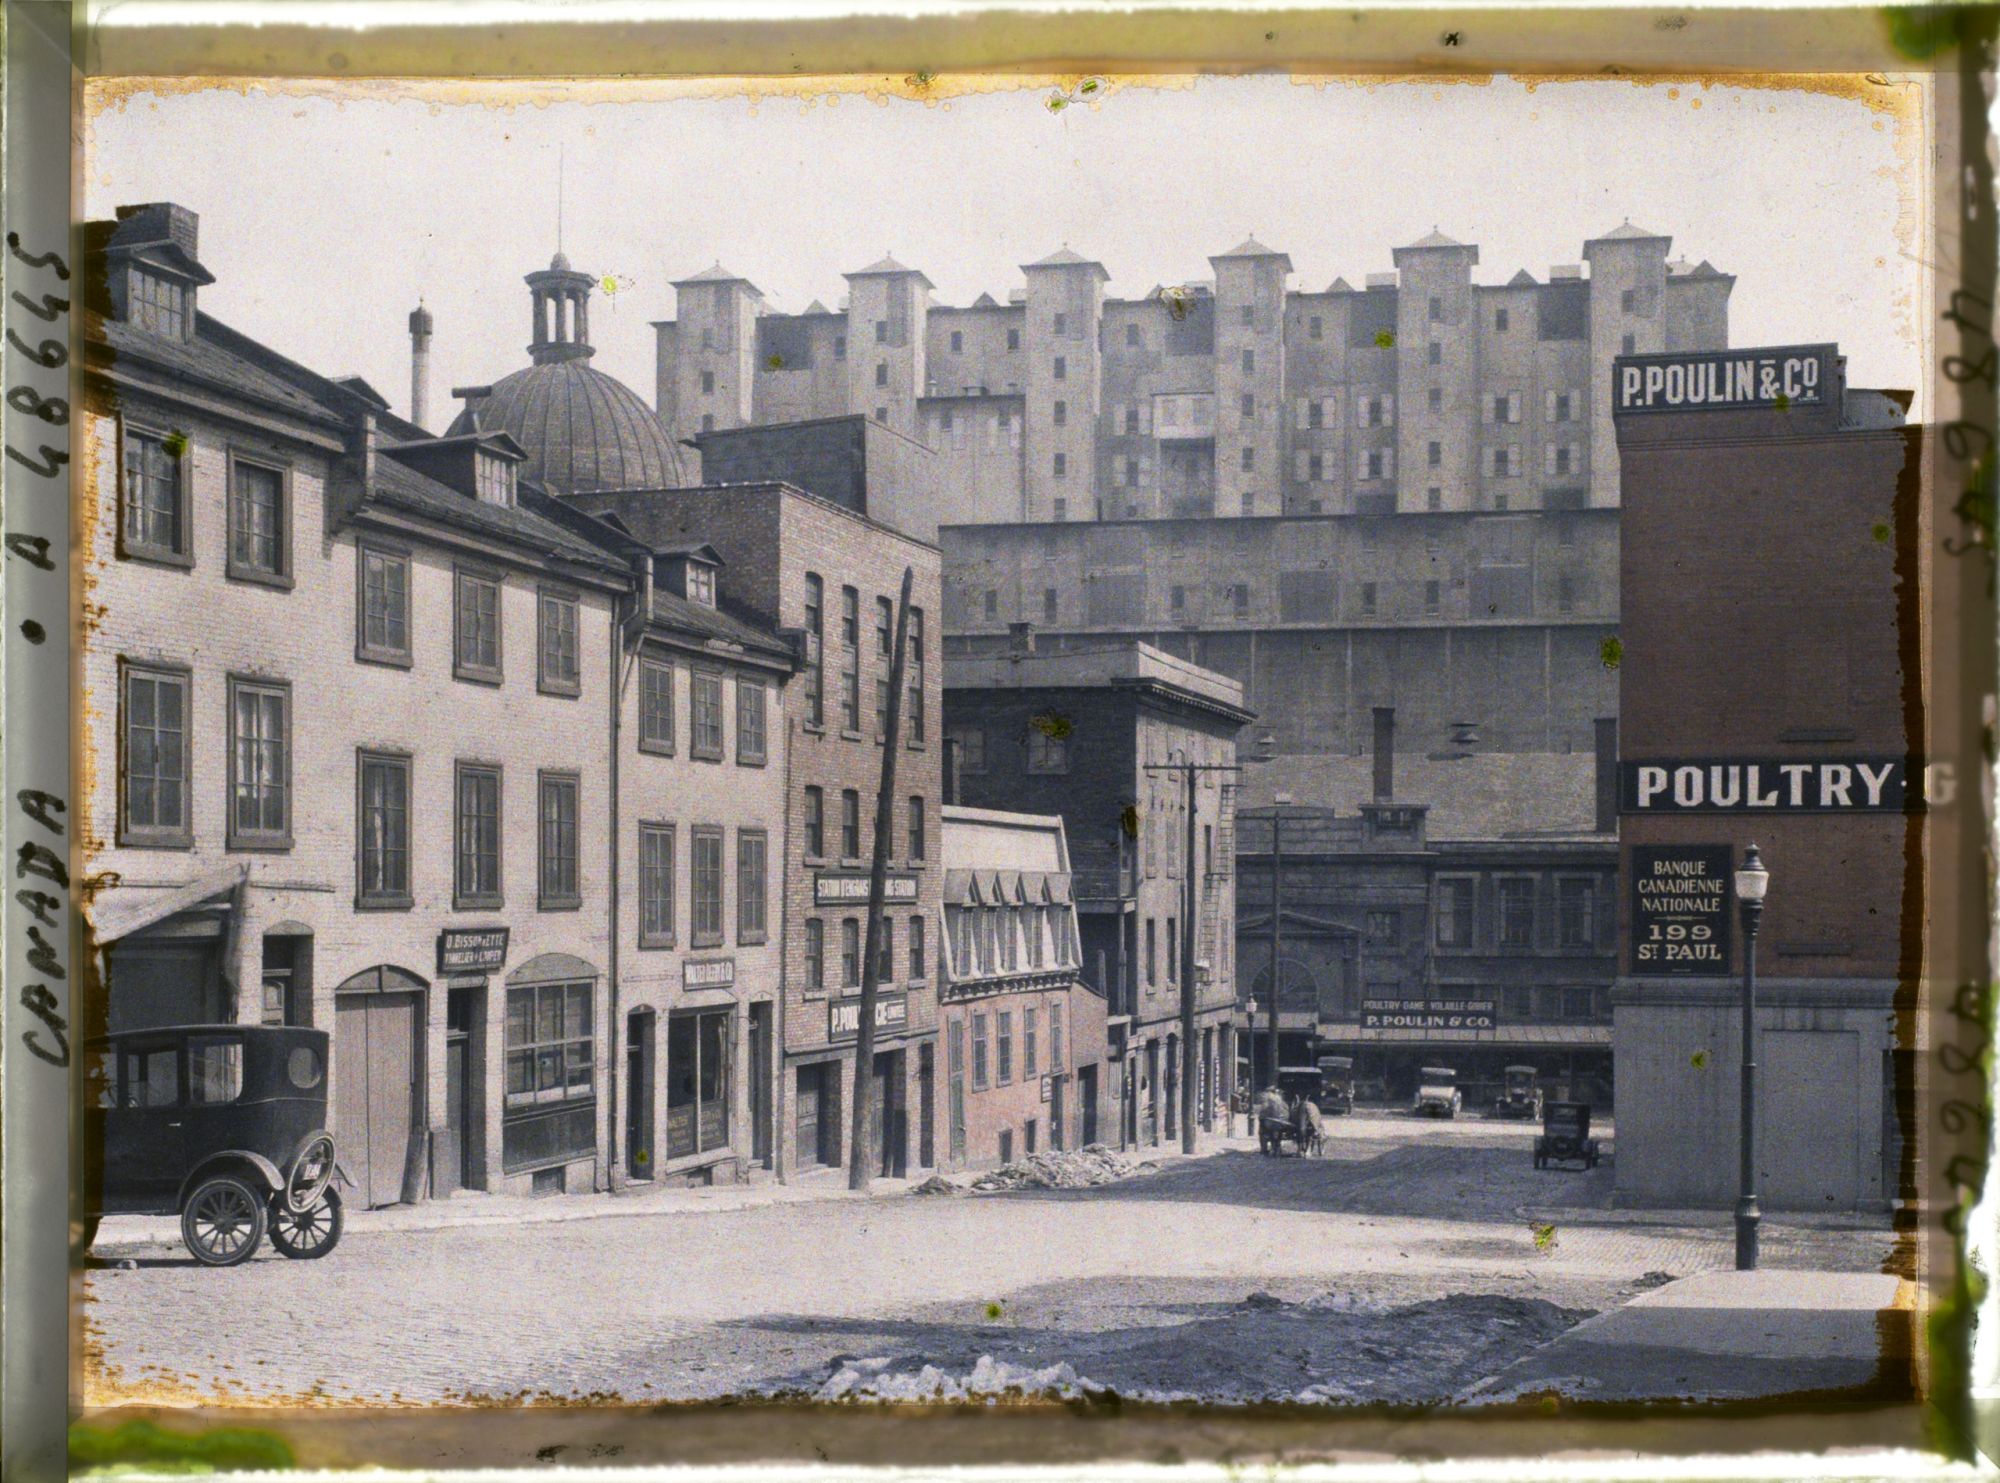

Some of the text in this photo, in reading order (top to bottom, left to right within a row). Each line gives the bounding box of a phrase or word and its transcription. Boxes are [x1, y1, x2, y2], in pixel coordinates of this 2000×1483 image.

[5, 231, 70, 479] 48645
[1638, 763, 1894, 807] POULTRY
[1654, 861, 1706, 876] BANQUE
[1638, 879, 1724, 894] CANADIENNE
[1642, 898, 1720, 912] NATIONALE
[15, 789, 70, 1068] CANADA
[1649, 924, 1712, 940] 199
[1665, 944, 1722, 960] PAUL
[1383, 1015, 1444, 1026] POULIN
[1448, 1016, 1462, 1027] &
